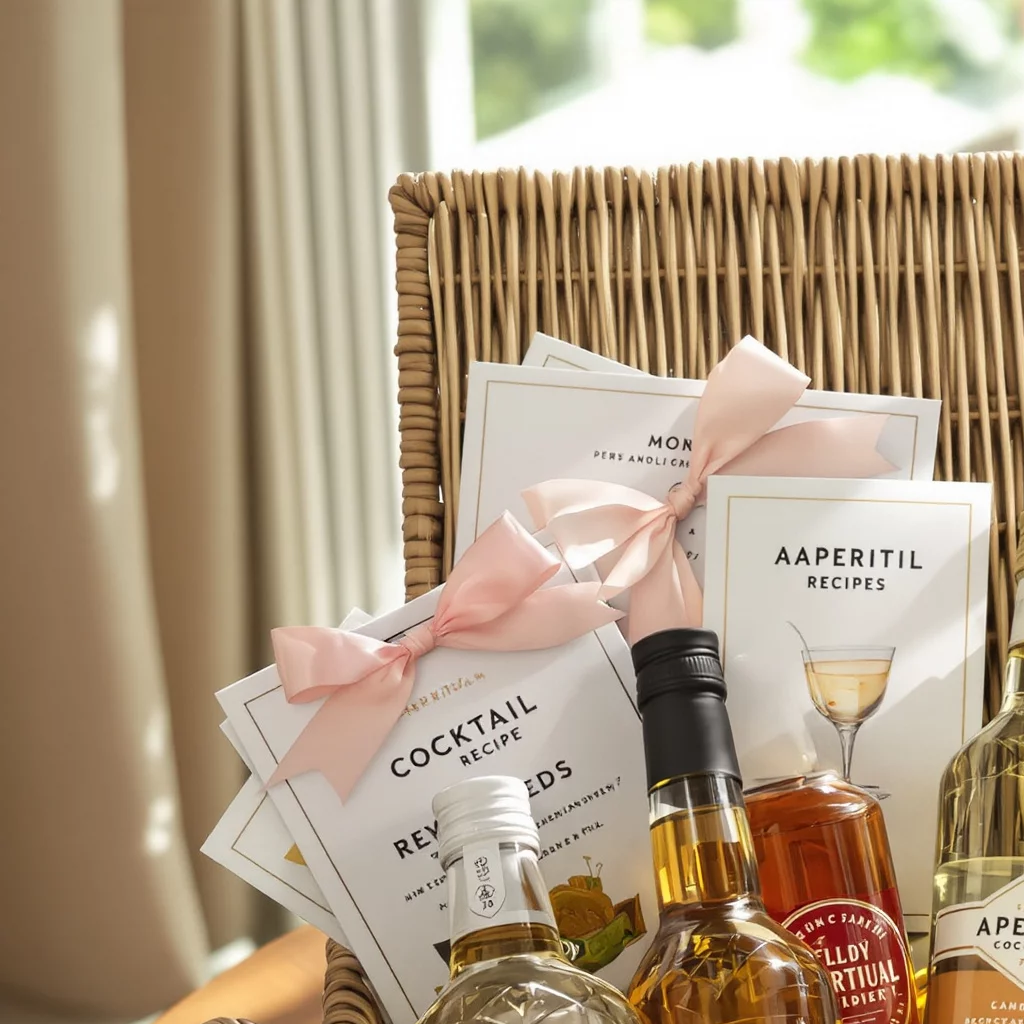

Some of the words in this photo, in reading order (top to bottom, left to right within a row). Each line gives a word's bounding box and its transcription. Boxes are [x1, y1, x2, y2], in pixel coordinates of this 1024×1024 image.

[774, 546, 923, 570] AAPERITIL
[807, 575, 886, 591] RECIPES
[390, 695, 538, 778] COCKTAIL
[459, 726, 523, 767] RECIPE
